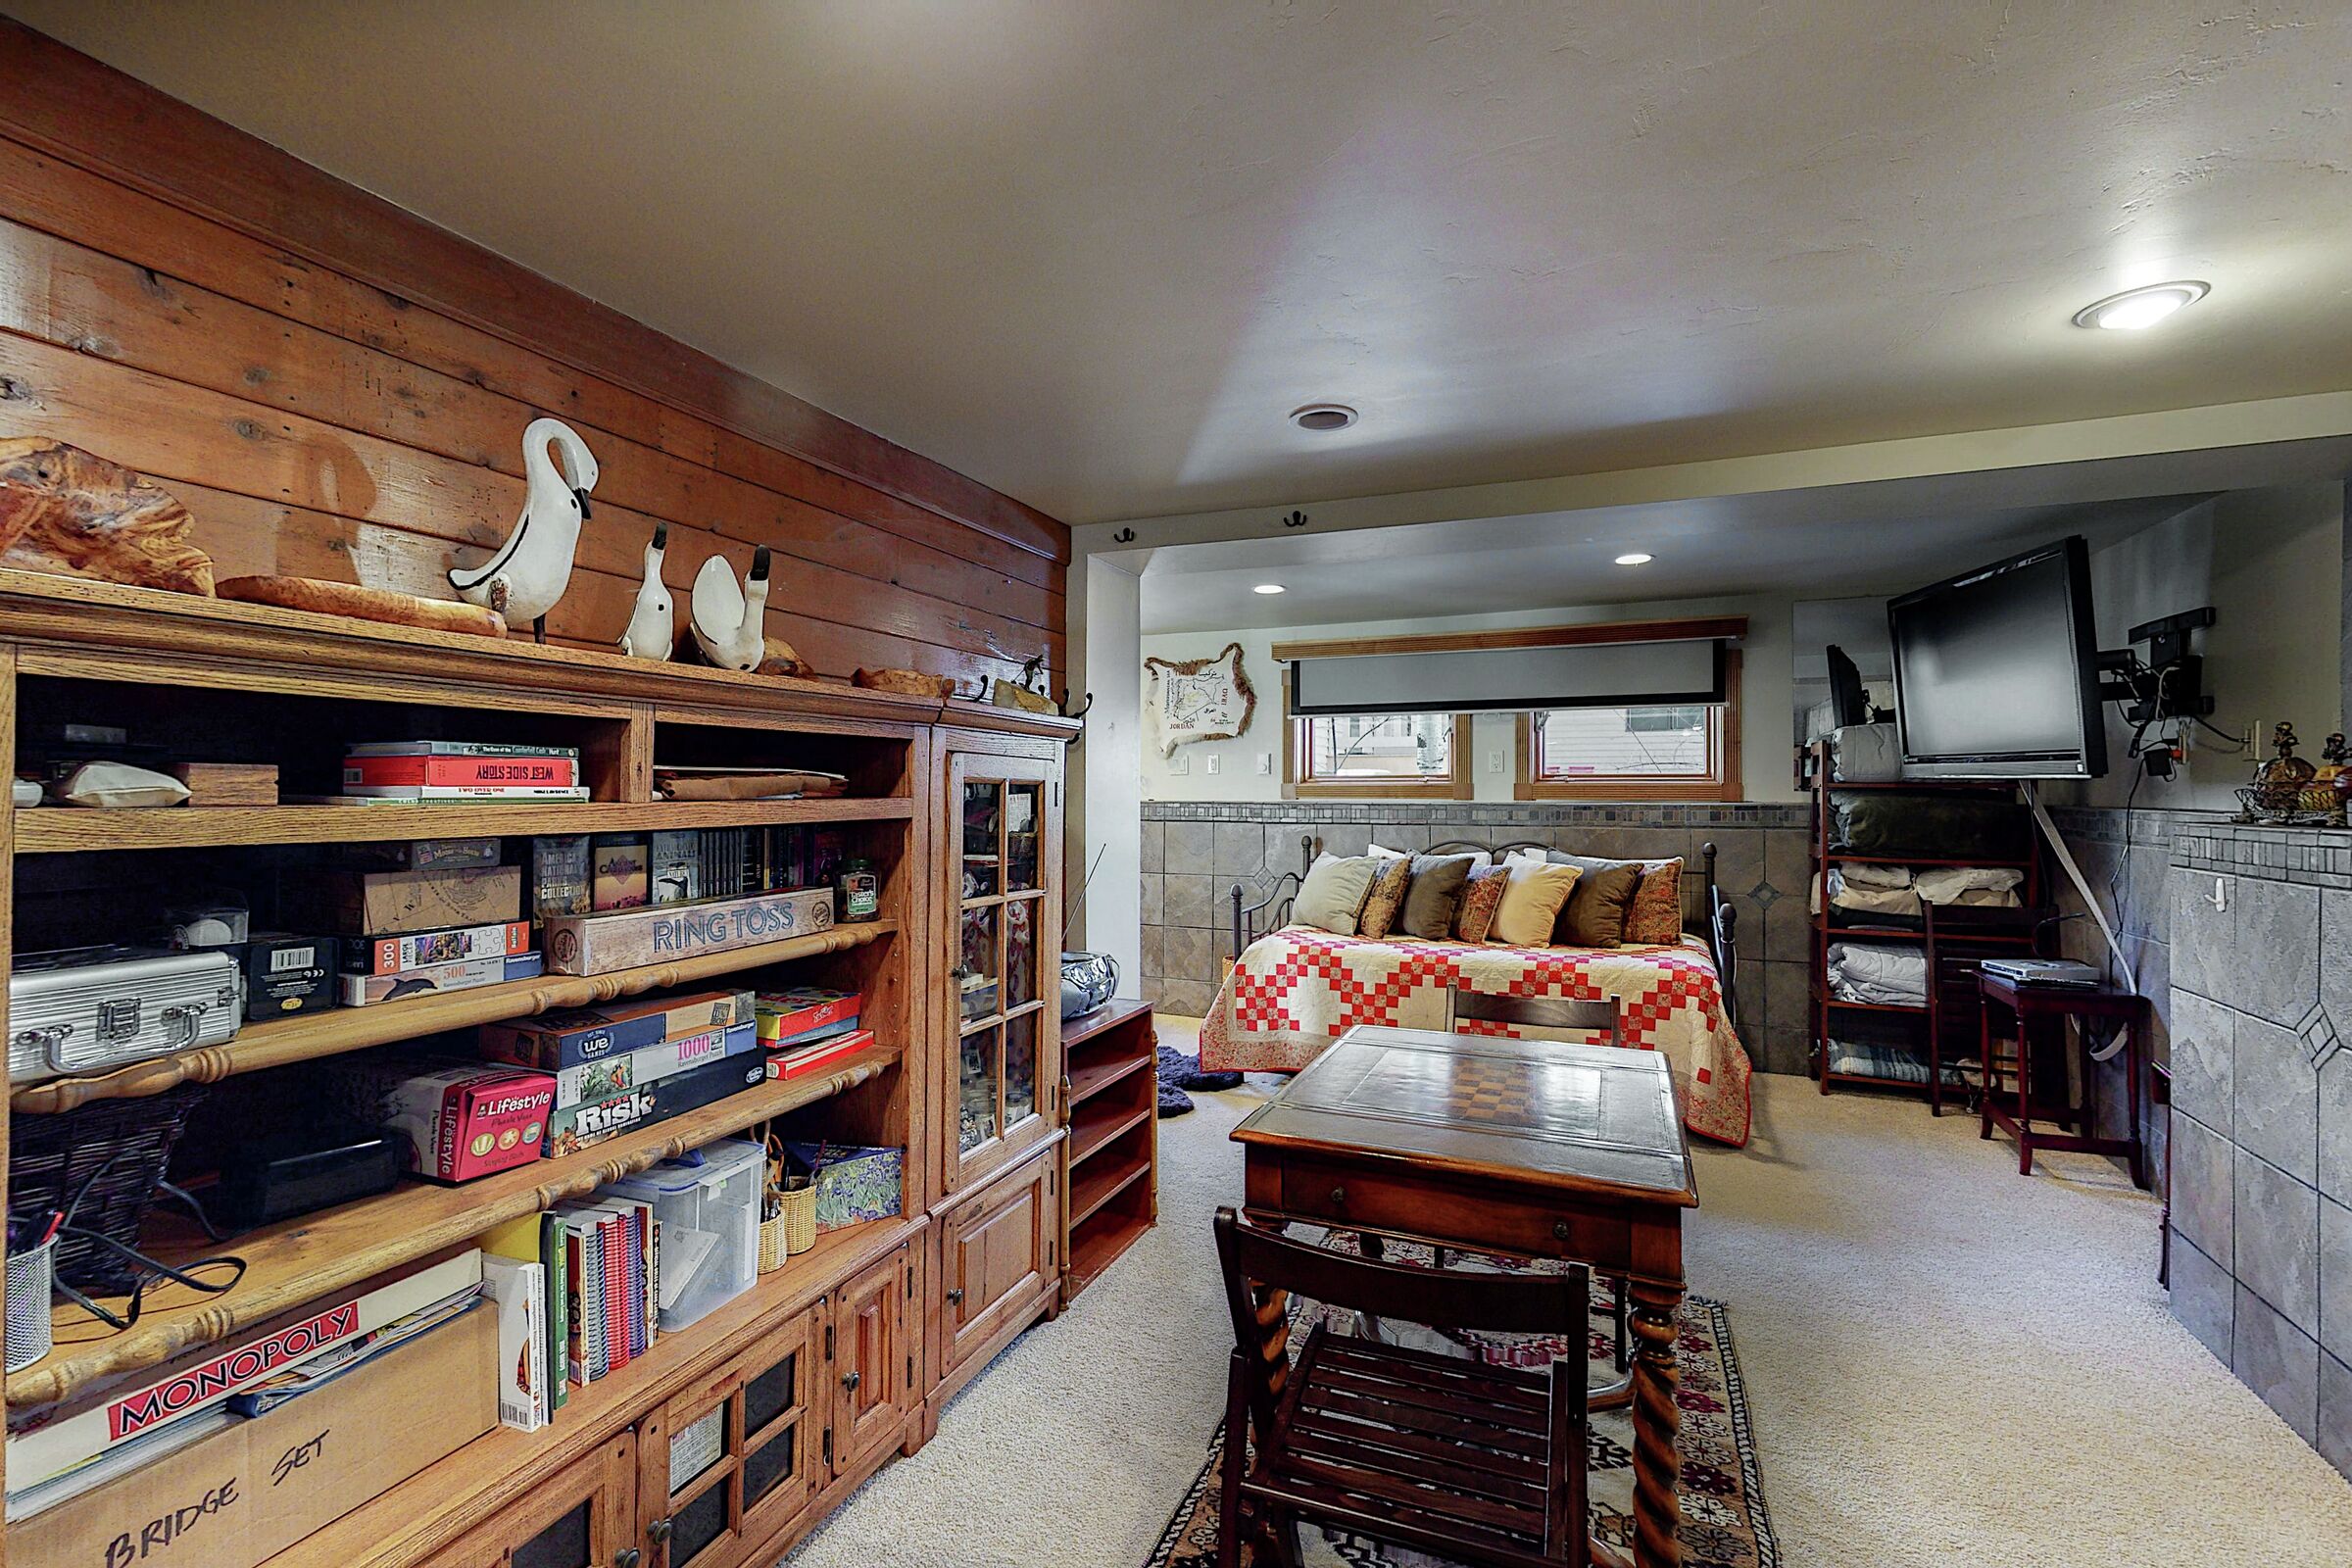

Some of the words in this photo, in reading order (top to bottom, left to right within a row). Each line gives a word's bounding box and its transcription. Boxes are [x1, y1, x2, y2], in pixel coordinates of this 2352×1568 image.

[476, 764, 505, 780] STORY
[506, 765, 529, 780] SIDE
[529, 766, 554, 780] WEST
[541, 884, 584, 900] COLLECTION
[653, 912, 726, 954] RING
[730, 901, 795, 939] TOSS
[383, 943, 395, 968] 300
[505, 954, 541, 964] Ravensburger
[443, 964, 466, 979] 500
[726, 1021, 755, 1034] Ravensburger
[583, 1037, 610, 1054] we
[677, 1034, 710, 1061] 1000
[677, 1054, 709, 1067] Ravensburger
[709, 1049, 723, 1059] Puzzle
[488, 1091, 551, 1116] Lifestyle
[441, 1105, 458, 1174] Lifestyle
[119, 1306, 356, 1435] MONOPOLY
[103, 1477, 240, 1568] BRIDGE
[270, 1429, 330, 1487] SET
